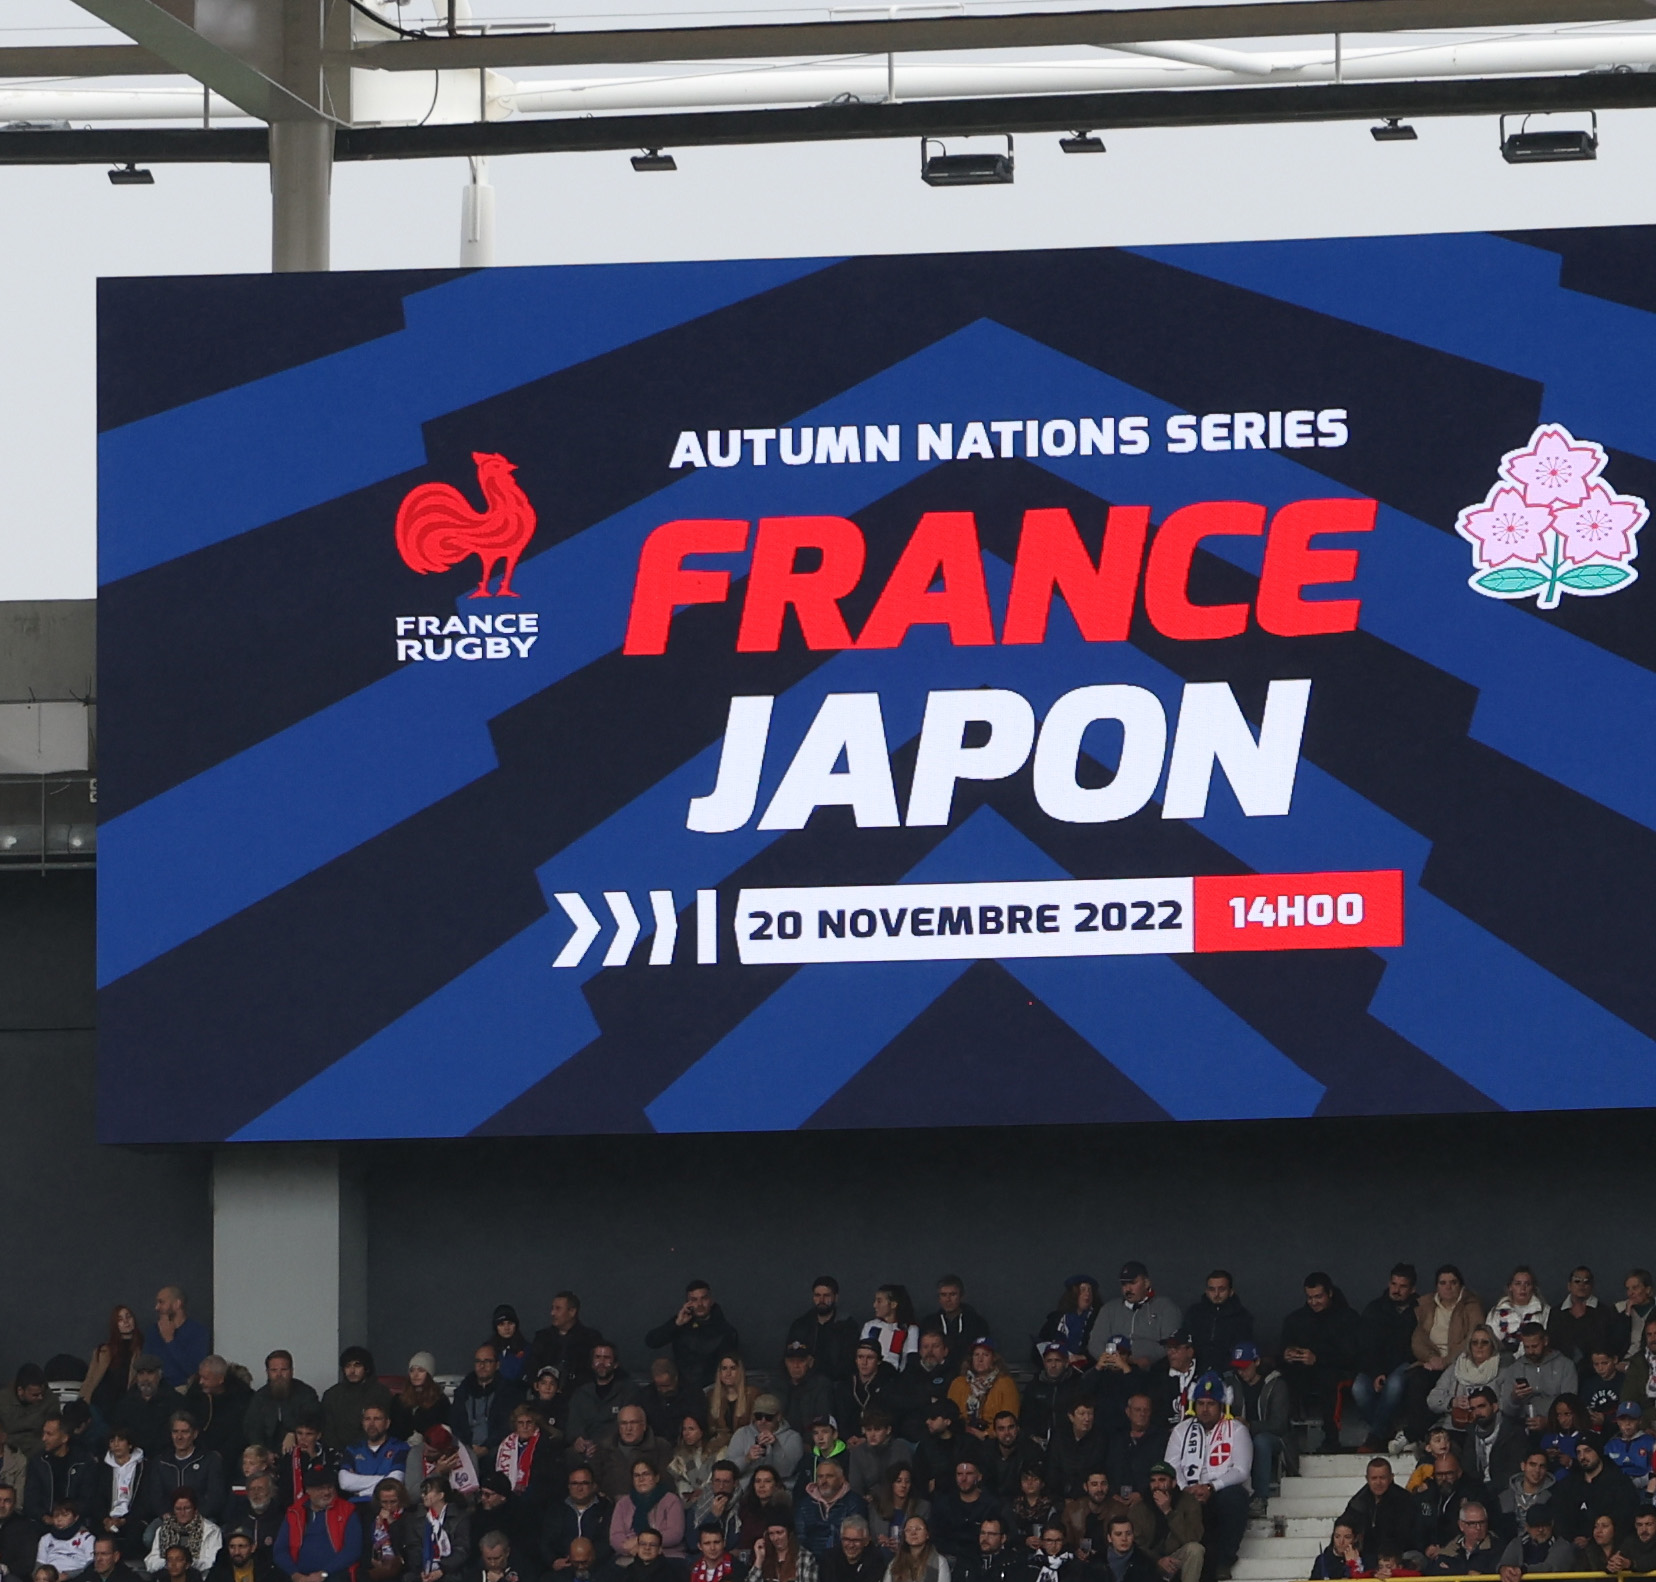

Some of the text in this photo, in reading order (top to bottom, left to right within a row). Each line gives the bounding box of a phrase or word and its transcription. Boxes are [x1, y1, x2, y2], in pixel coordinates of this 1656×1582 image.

[669, 408, 1349, 469] AUTUMN NATIONS SERIES
[623, 497, 1379, 656] FRANCE
[395, 613, 540, 637] FRANCE
[395, 635, 539, 662] RUGBY
[686, 678, 1312, 834] JAPON
[748, 898, 1184, 942] 20 NOVEMBRE 2022
[1228, 891, 1365, 929] 14H00
